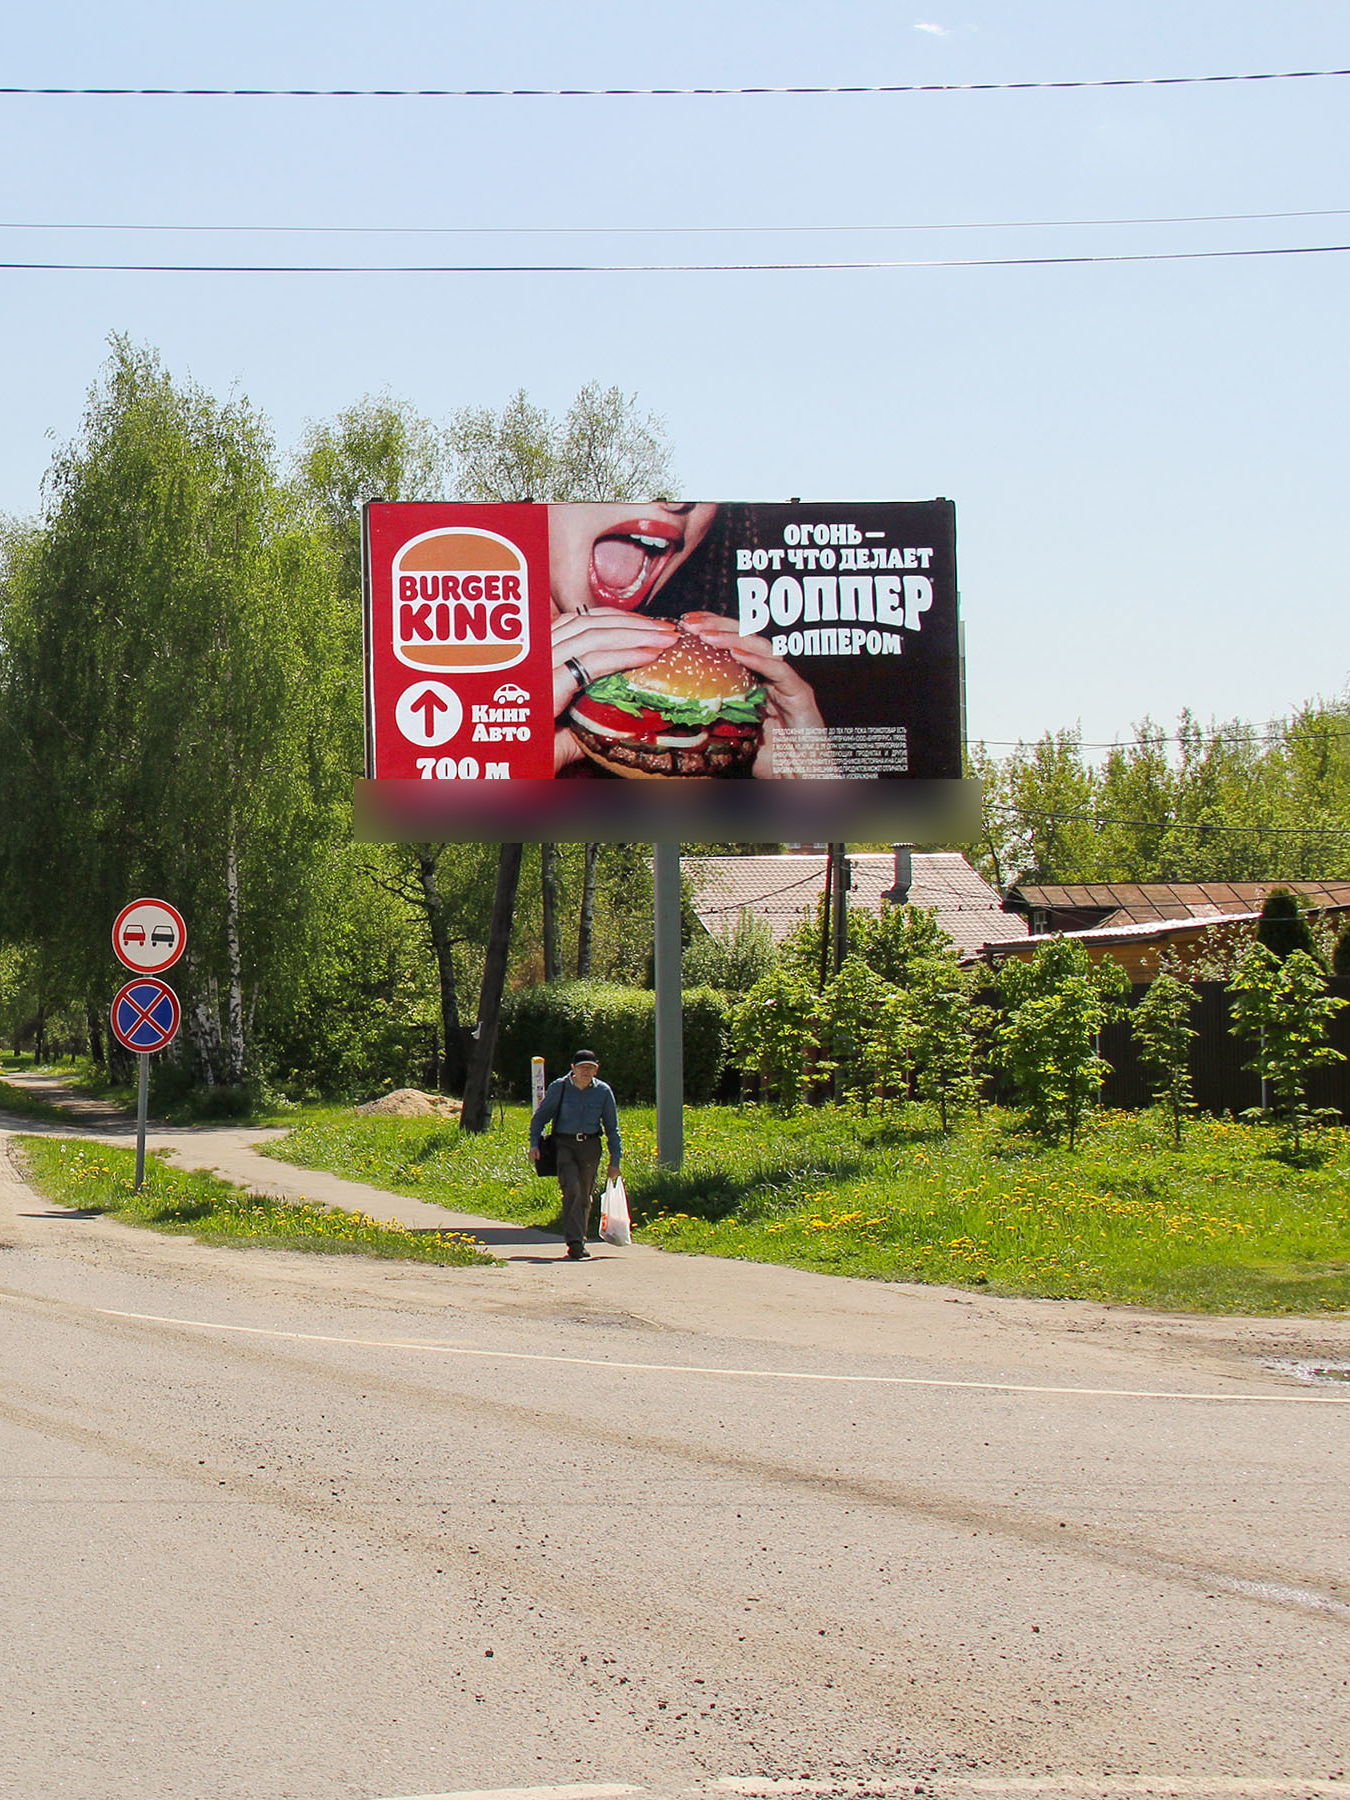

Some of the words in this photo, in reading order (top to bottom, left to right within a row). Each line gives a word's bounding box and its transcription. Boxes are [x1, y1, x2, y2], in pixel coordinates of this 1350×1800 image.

[783, 523, 863, 546] ОГОНЬ
[736, 548, 785, 571] ВОТ
[787, 548, 837, 570] ЧТО
[838, 547, 934, 571] ДЕЛАЕТ
[399, 575, 522, 602] BURGER
[736, 575, 934, 637] ВОППЕР
[399, 602, 523, 642] KING
[771, 627, 902, 657] ВОППЕРОМ
[416, 757, 480, 780] 700
